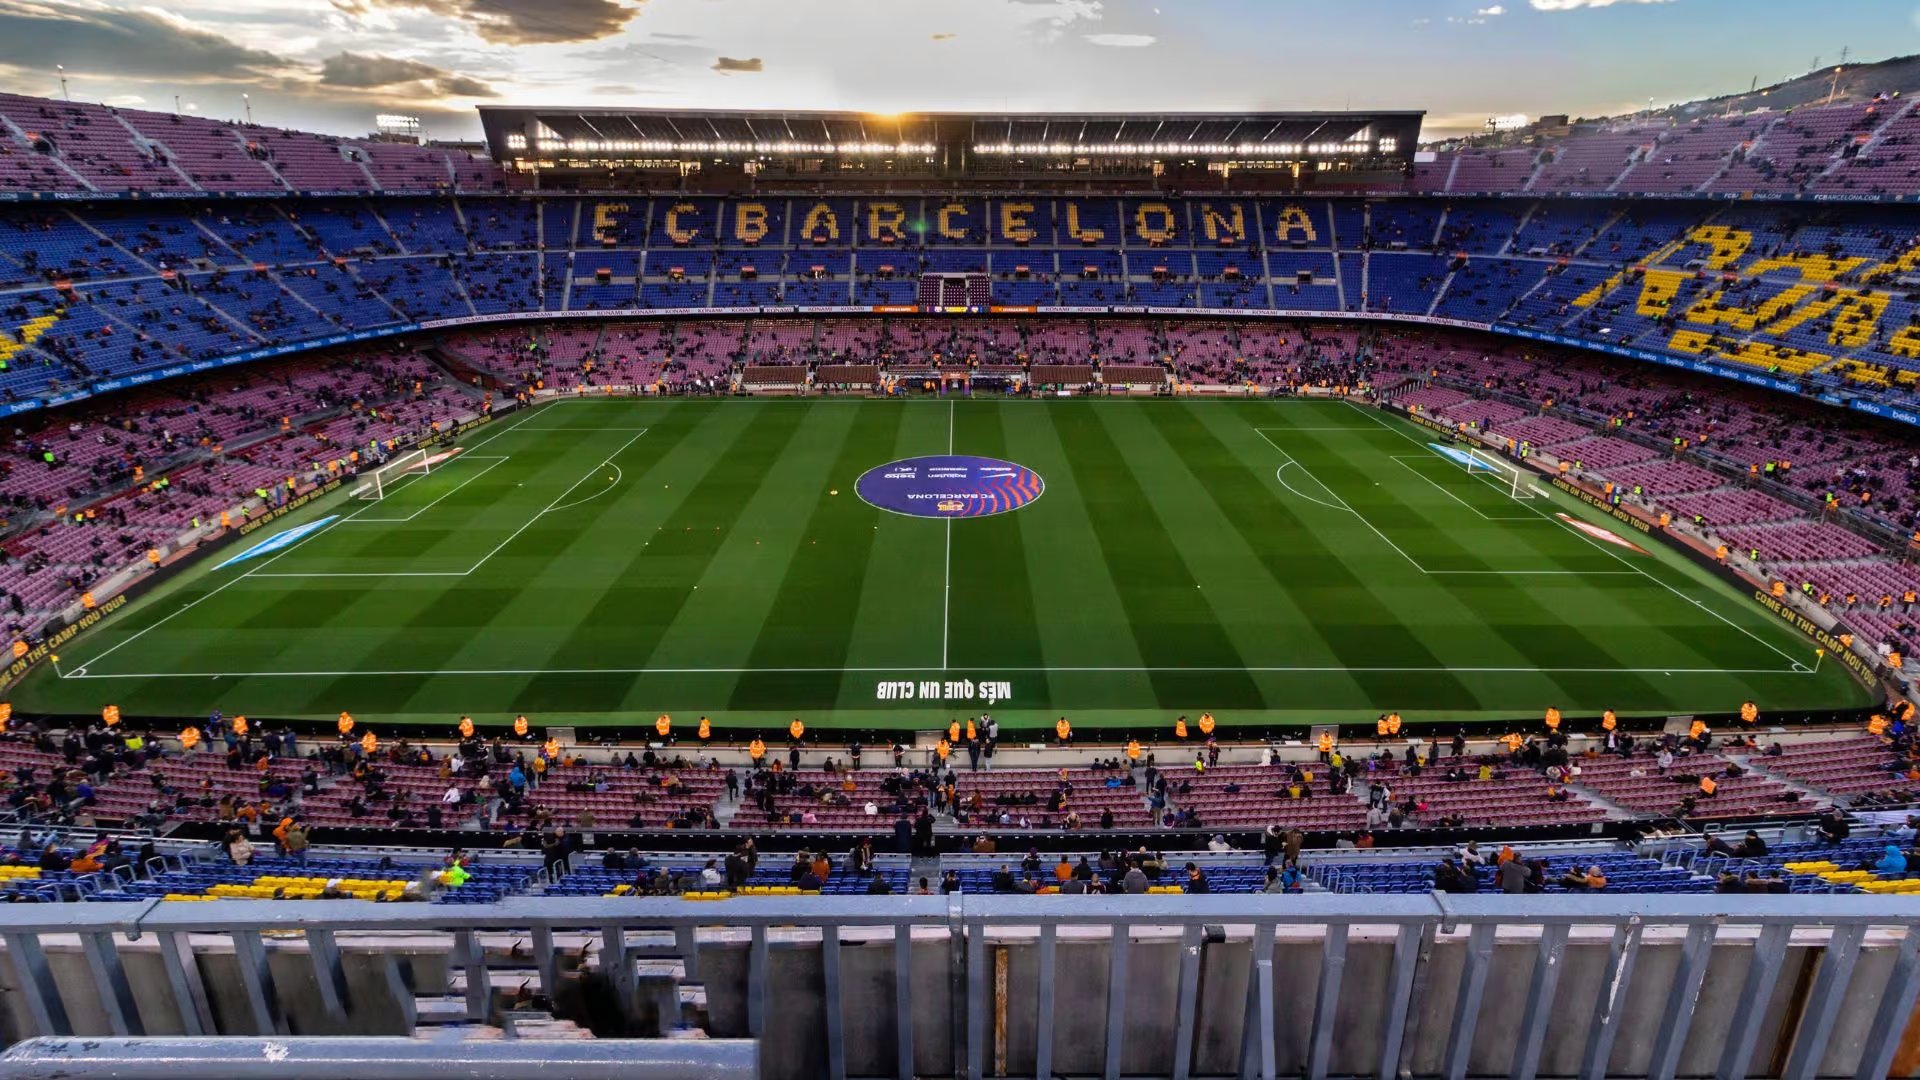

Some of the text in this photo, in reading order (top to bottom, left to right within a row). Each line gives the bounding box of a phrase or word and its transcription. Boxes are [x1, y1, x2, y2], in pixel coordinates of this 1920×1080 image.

[1462, 320, 1488, 329] KONAMI
[98, 382, 121, 391] beko
[131, 373, 153, 384] beko
[163, 367, 184, 376] beko
[193, 361, 212, 370] beko
[1494, 326, 1796, 392] beko beko beko beko beko beko beko beko beko beko beko beko
[10, 401, 36, 412] beko
[1857, 401, 1917, 424] beko beko
[418, 438, 433, 449] COME
[468, 420, 478, 429] NOU
[478, 415, 491, 424] TOUR
[1410, 414, 1424, 424] COME
[1431, 423, 1441, 431] THE
[1468, 438, 1481, 448] TOUR
[240, 519, 263, 535] COME
[263, 513, 274, 523] ON
[274, 506, 288, 517] THE
[288, 495, 309, 509] CAMP
[309, 487, 324, 500] NOU
[324, 479, 341, 493] TOUR
[1552, 478, 1570, 492] COME
[1570, 486, 1580, 496] ON
[1580, 492, 1592, 503] THE
[1593, 498, 1613, 513] CAMP
[1612, 508, 1629, 521] NOU
[1630, 517, 1650, 533] TOUR
[0, 594, 127, 690] ME ON THE CAMP NOU TOUR
[1755, 591, 1877, 687] COME ON THE CAMP NOU TOUR
[877, 679, 1011, 705] MÉS QUE UN CLUB
